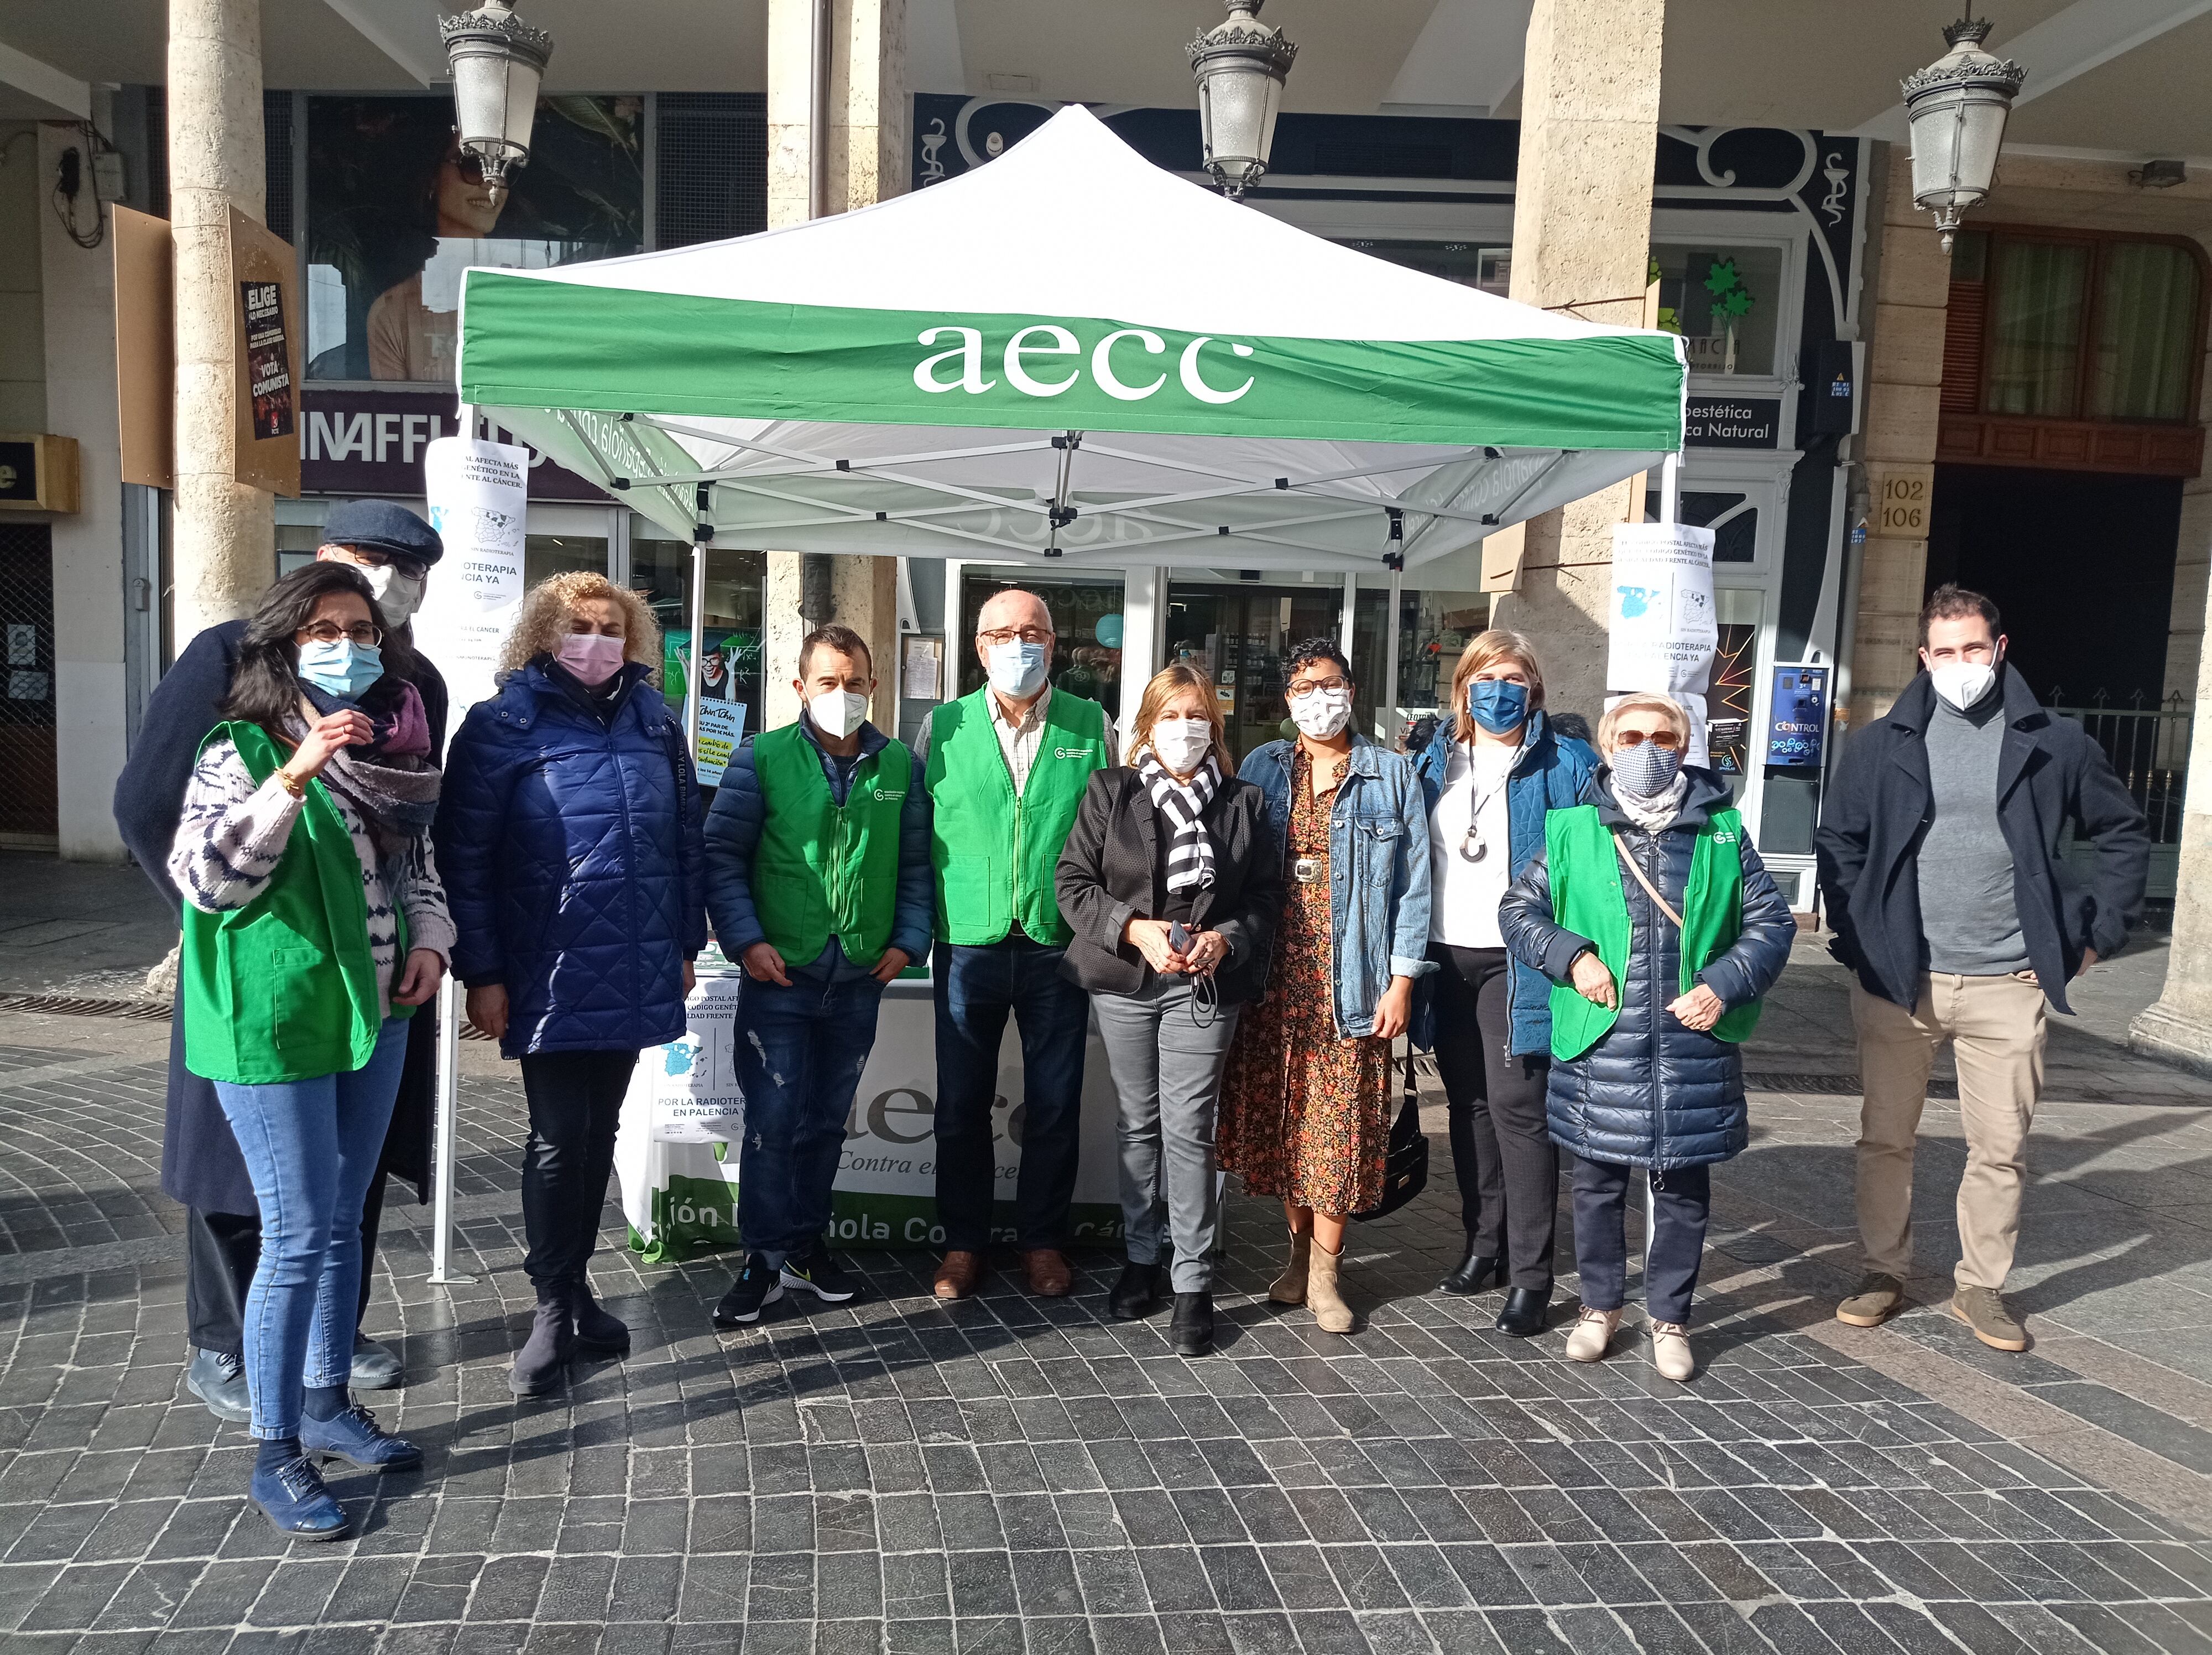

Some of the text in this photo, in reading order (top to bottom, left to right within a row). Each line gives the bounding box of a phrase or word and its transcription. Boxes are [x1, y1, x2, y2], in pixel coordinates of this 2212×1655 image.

[248, 285, 276, 310] ELIGE
[250, 306, 278, 320] LO NECESARIO
[261, 360, 278, 378] VOTA
[913, 324, 1255, 404] aecc
[253, 373, 289, 397] COMUNISTA
[1708, 423, 1768, 439] Natural
[475, 457, 502, 467] AFECTA
[503, 462, 519, 470] MÁS
[493, 477, 523, 489] CÁNCER.
[1886, 479, 1923, 501] 102
[1884, 507, 1921, 528] 106
[480, 548, 514, 556] RADIOTERAPIA
[1673, 549, 1697, 557] GENÉTICO
[461, 562, 517, 575] OTERAPIA
[486, 575, 499, 584] YA
[1645, 653, 1688, 661] ALENCIA
[1775, 721, 1820, 733] CONTROL
[701, 739, 729, 750] cambio de
[690, 1107, 739, 1116] PALENCIA
[837, 1151, 912, 1174] Contra
[670, 1196, 717, 1227] ión
